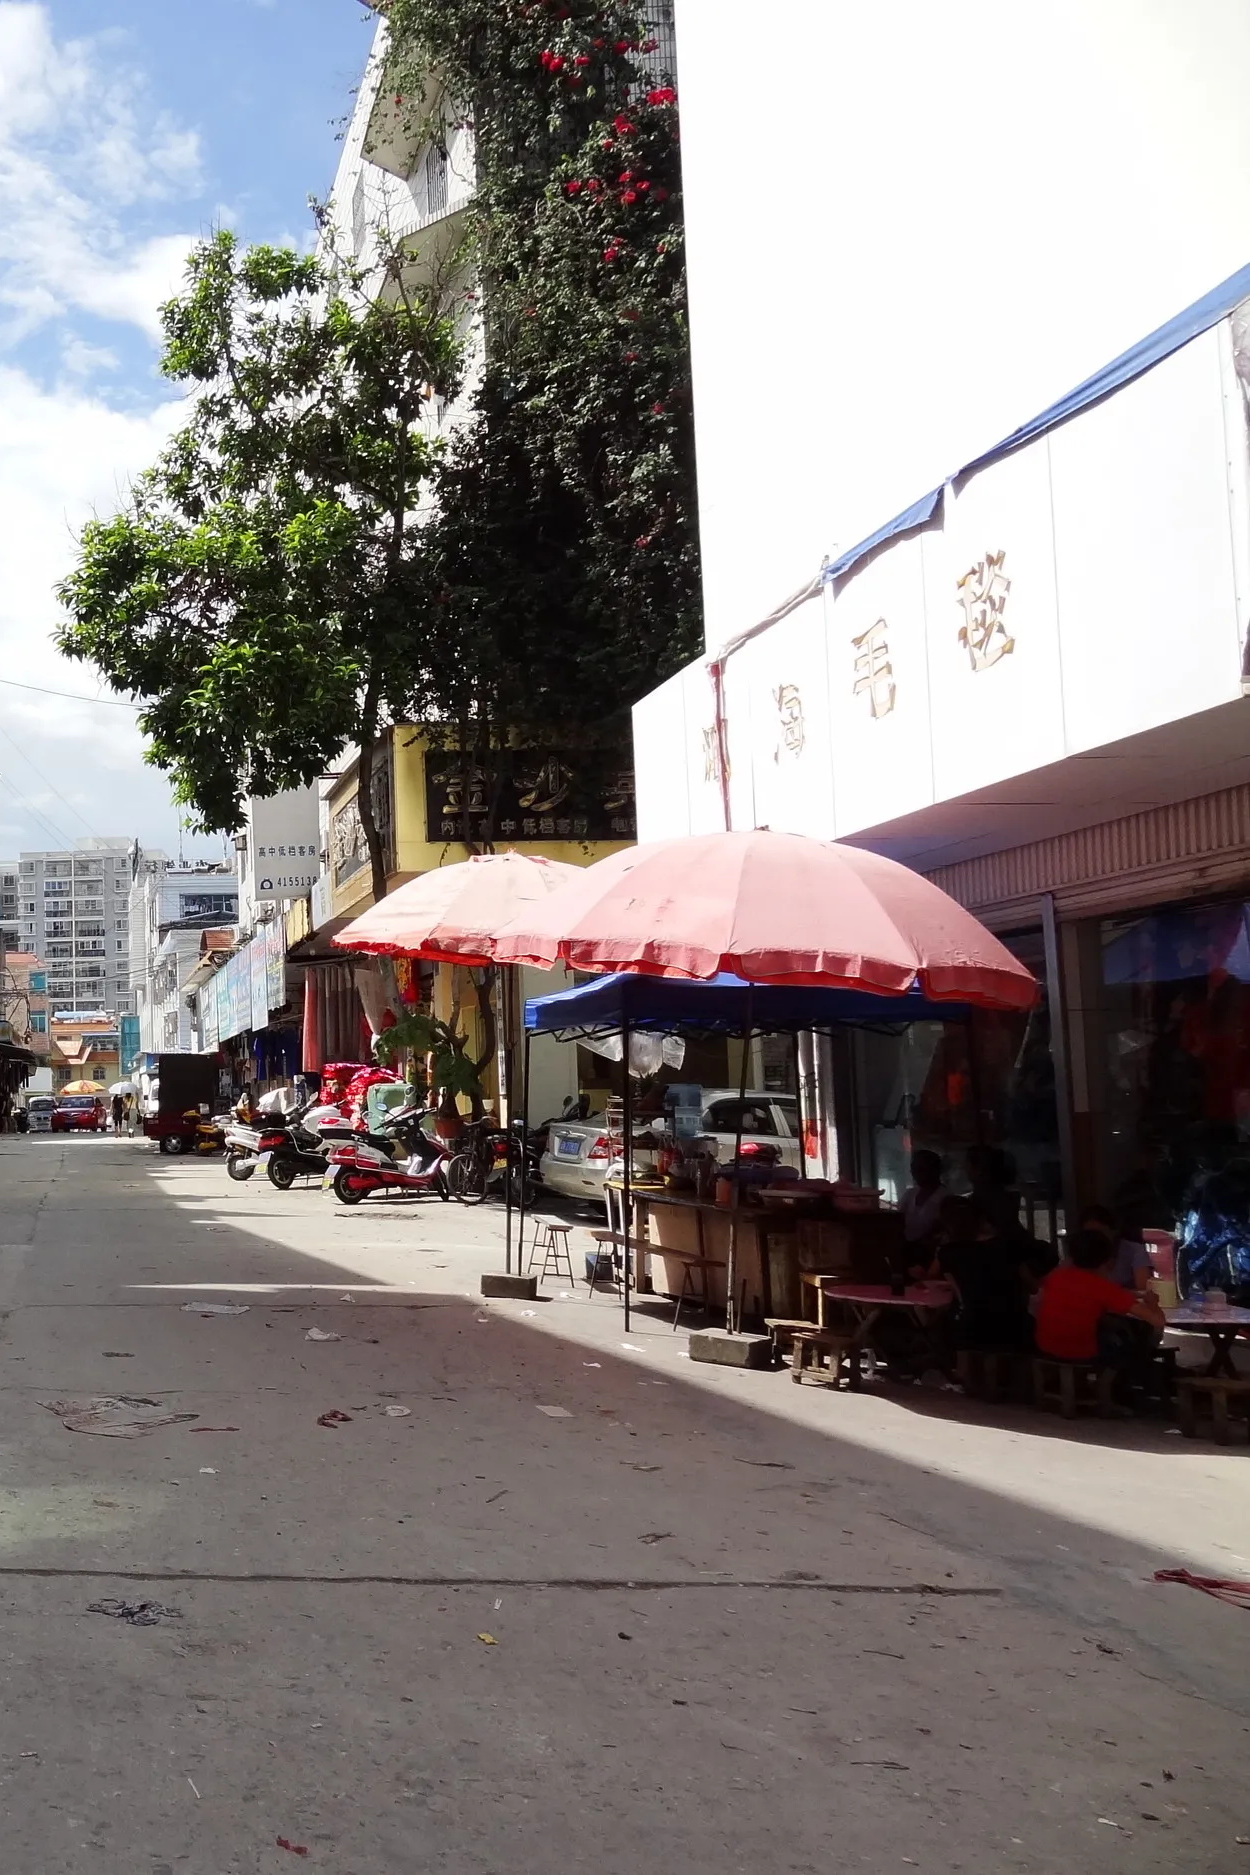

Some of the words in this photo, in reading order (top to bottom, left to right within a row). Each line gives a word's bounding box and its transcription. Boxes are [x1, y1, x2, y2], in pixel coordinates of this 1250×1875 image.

[258, 845, 316, 858] 高中低档客房
[277, 875, 318, 888] 4155138
